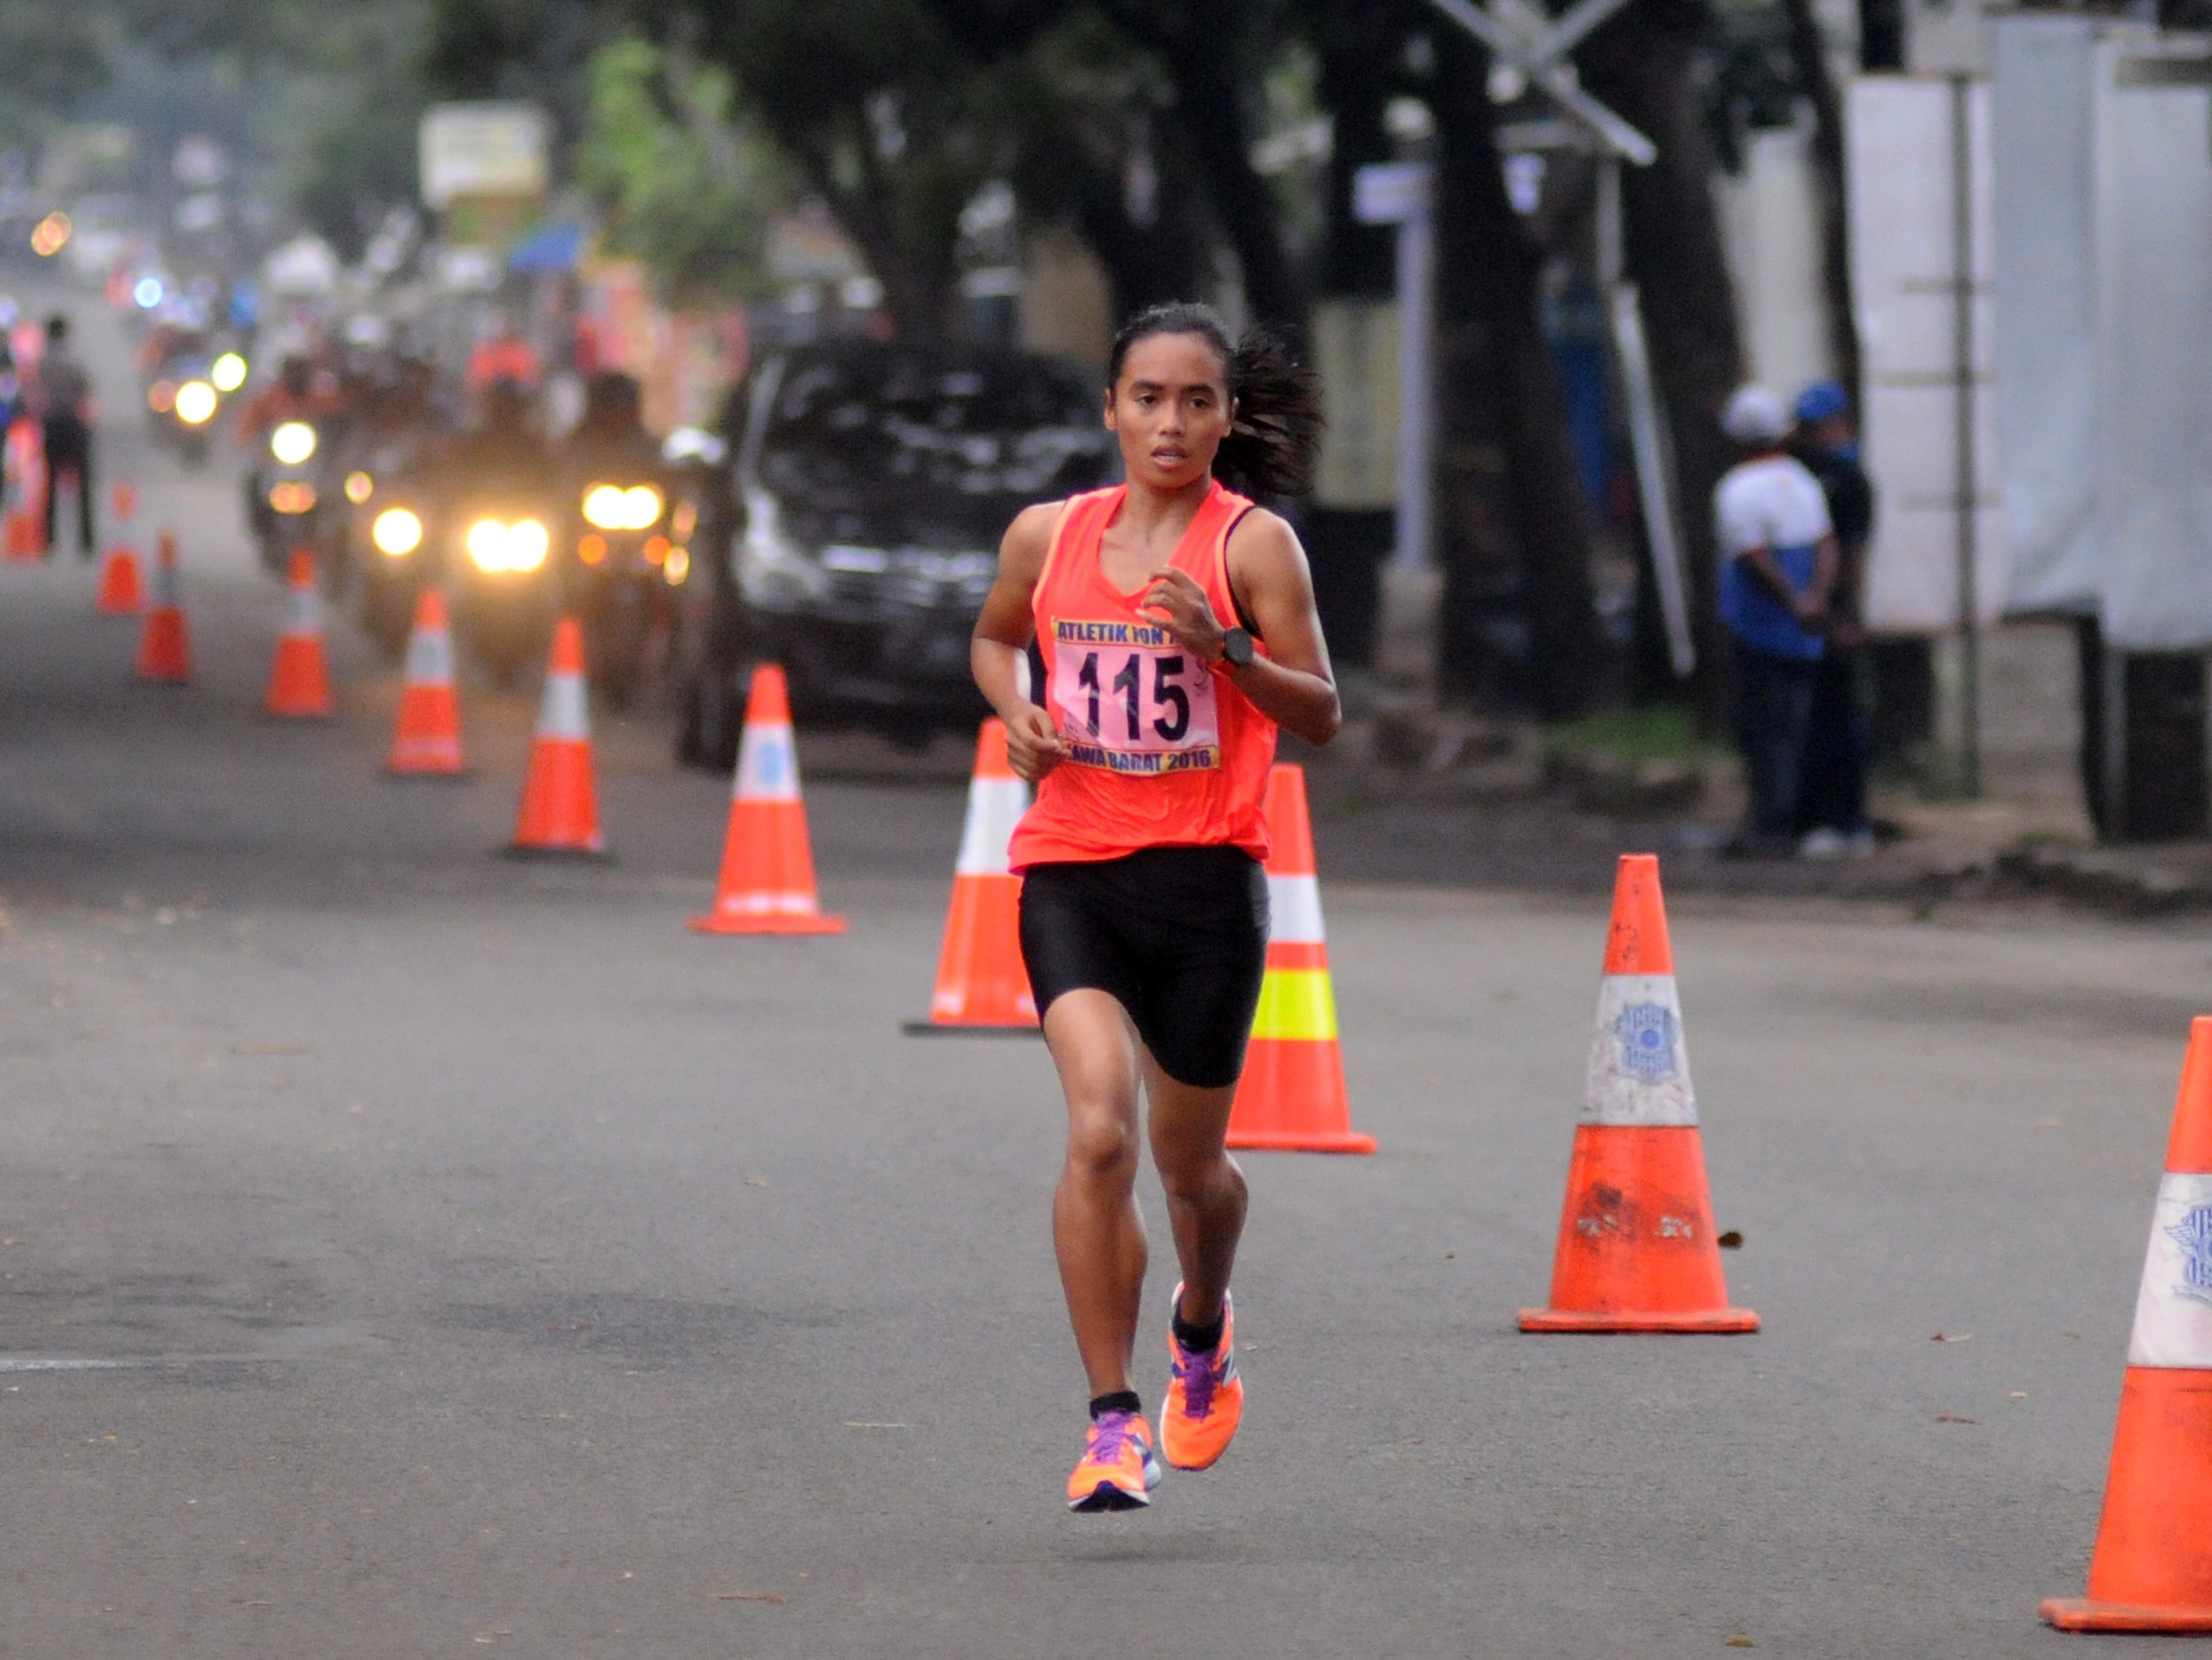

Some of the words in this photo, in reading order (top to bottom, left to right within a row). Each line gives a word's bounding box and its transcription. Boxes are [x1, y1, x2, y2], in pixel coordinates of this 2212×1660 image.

[1058, 622, 1128, 642] ATLETIK
[1078, 652, 1190, 741] 115
[1108, 751, 1161, 771] BARAT
[1168, 749, 1211, 770] 2016
